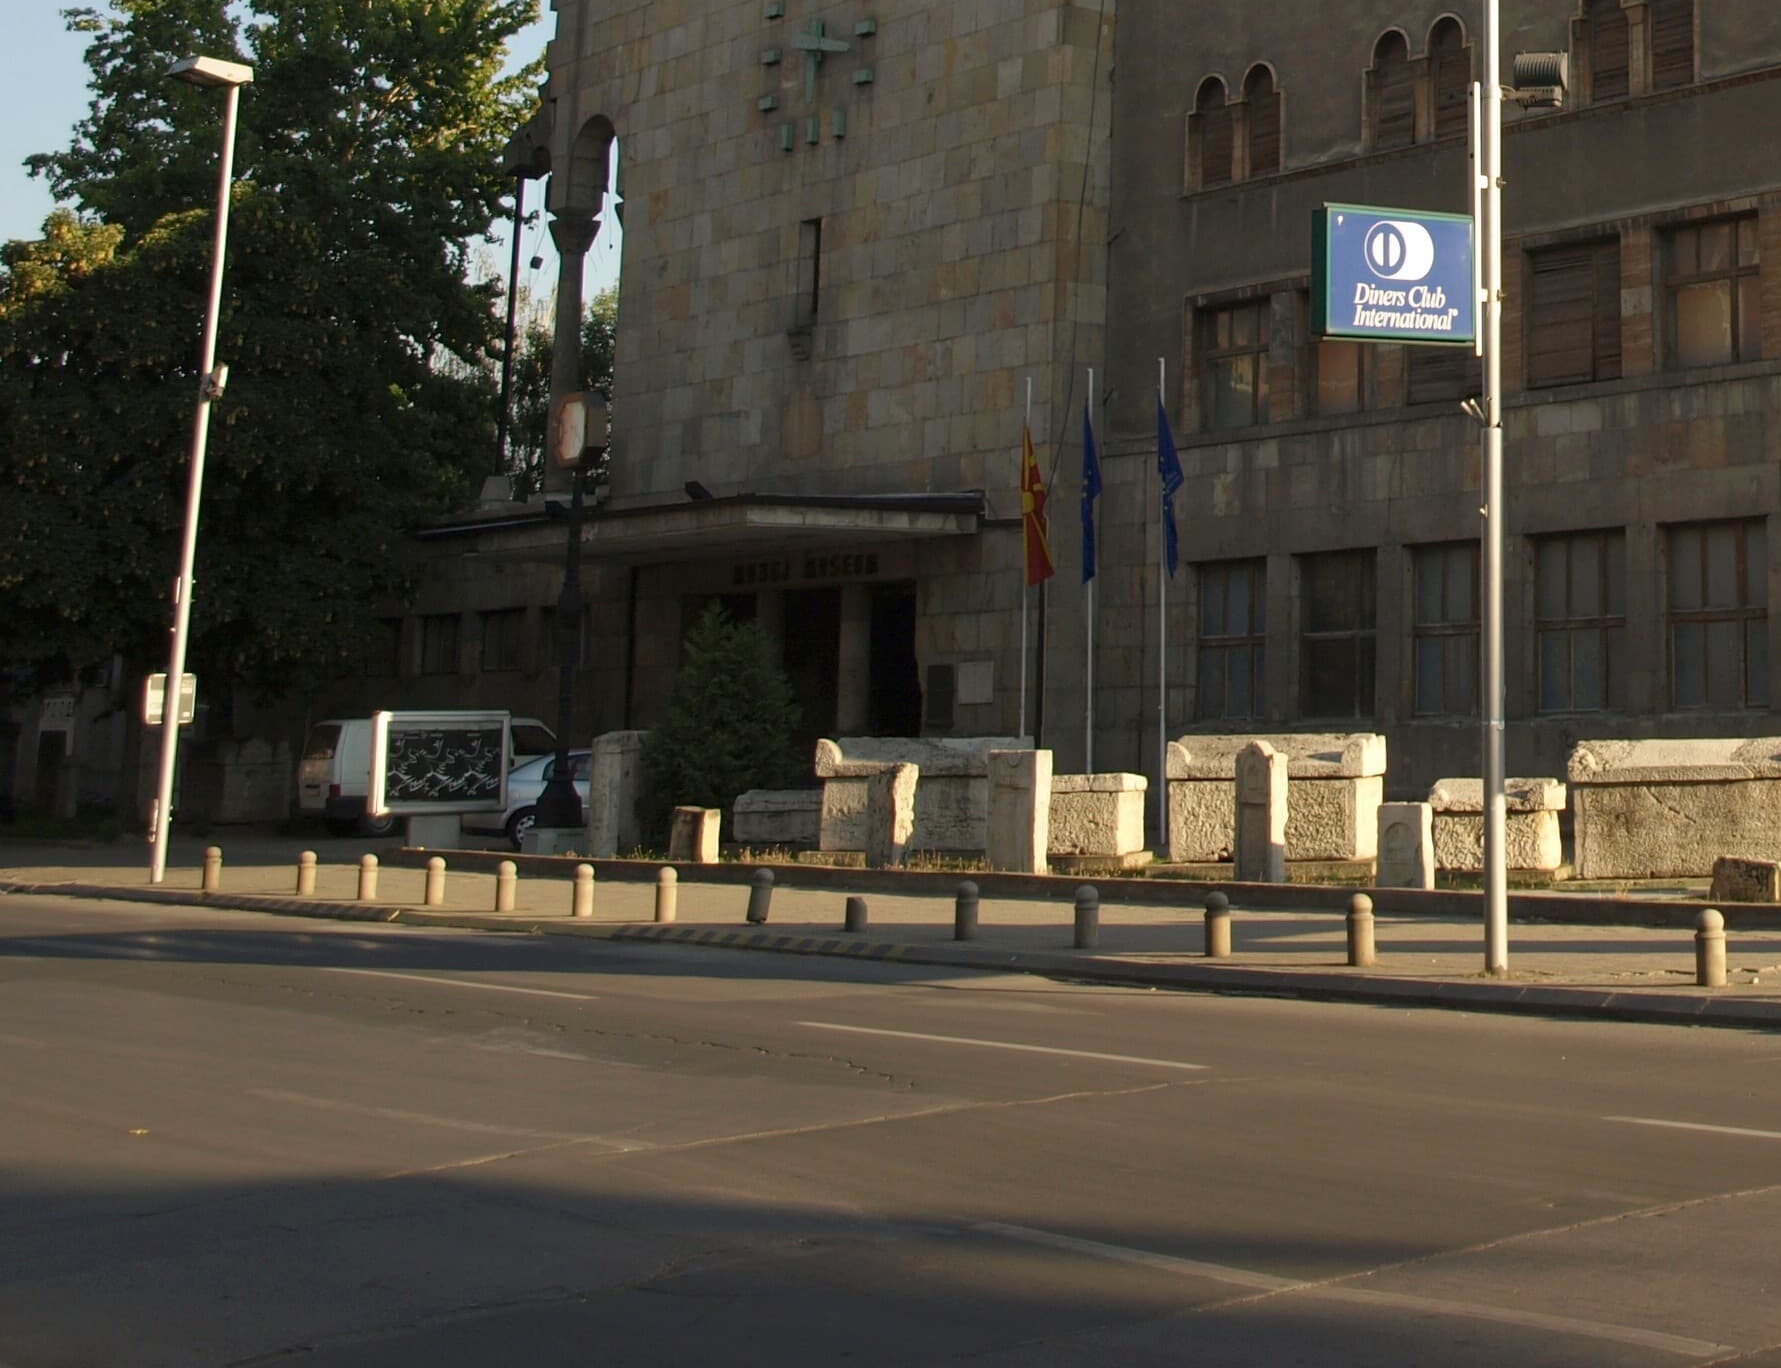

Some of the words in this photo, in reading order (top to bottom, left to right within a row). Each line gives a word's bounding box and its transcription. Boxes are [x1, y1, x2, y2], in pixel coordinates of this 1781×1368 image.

[1354, 283, 1406, 307] Diners
[1408, 285, 1446, 309] Club
[1353, 305, 1453, 330] International
